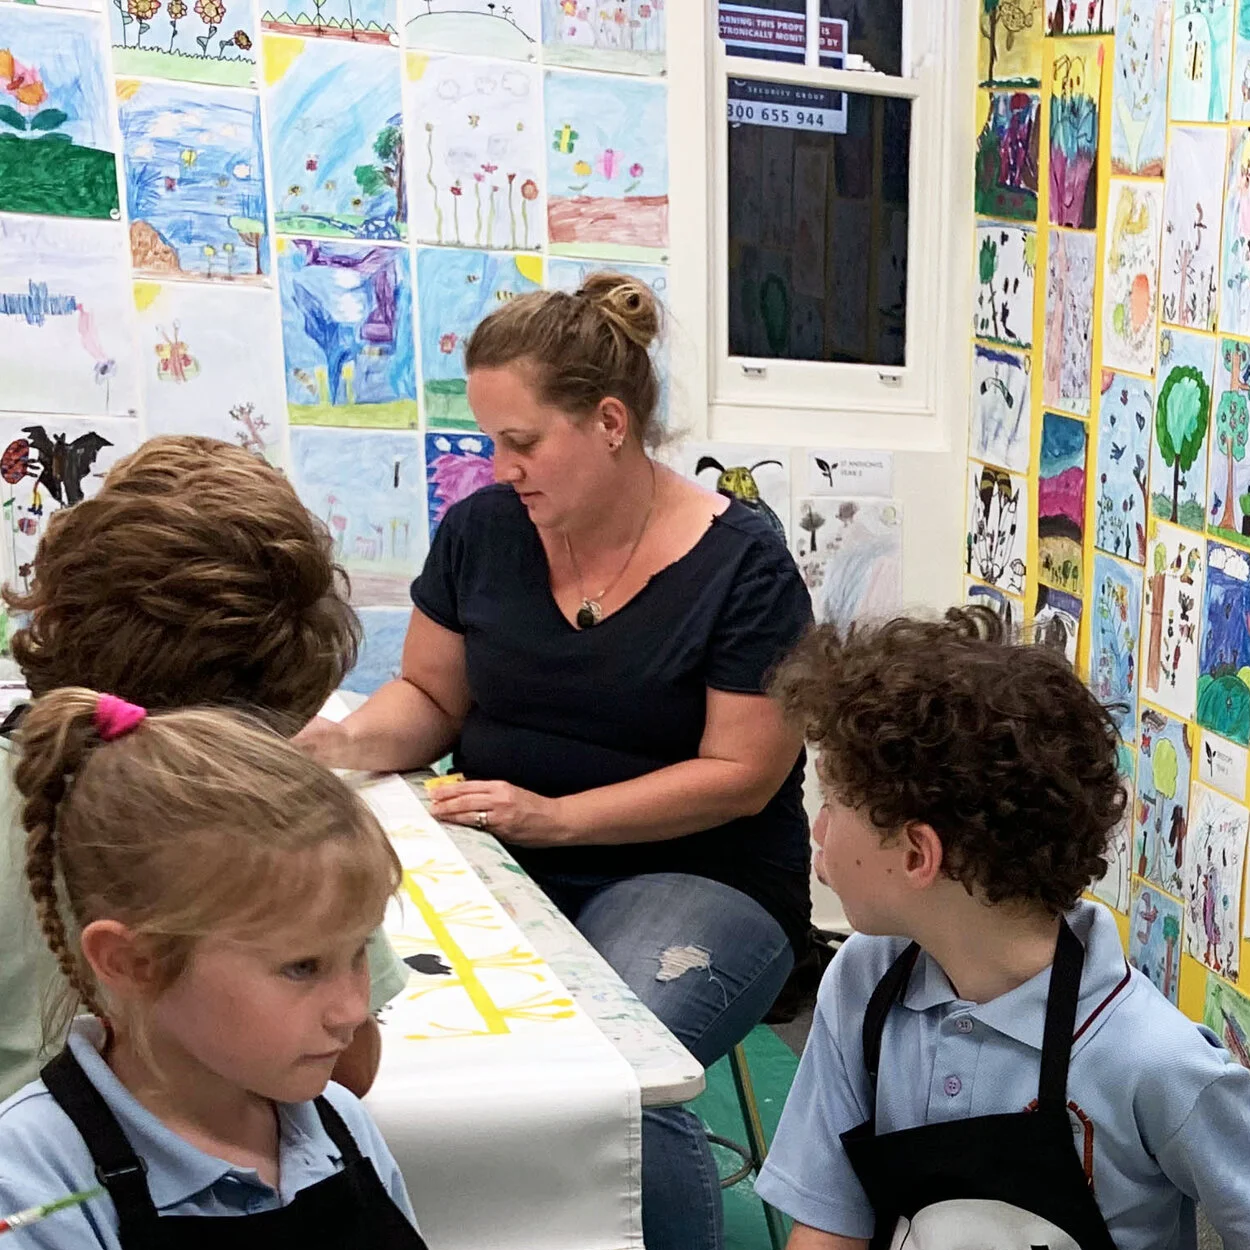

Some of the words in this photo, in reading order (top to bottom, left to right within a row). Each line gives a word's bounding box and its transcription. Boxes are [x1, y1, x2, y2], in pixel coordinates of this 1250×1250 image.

[719, 15, 754, 27] ARNING:
[756, 19, 775, 29] THIS
[821, 27, 830, 35] IS
[719, 26, 773, 38] CTRONICALLY
[827, 38, 838, 46] BY
[747, 86, 791, 97] SECURITY
[795, 92, 825, 100] GROUP
[728, 104, 754, 119] 300
[761, 108, 789, 123] 655
[796, 112, 824, 126] 944
